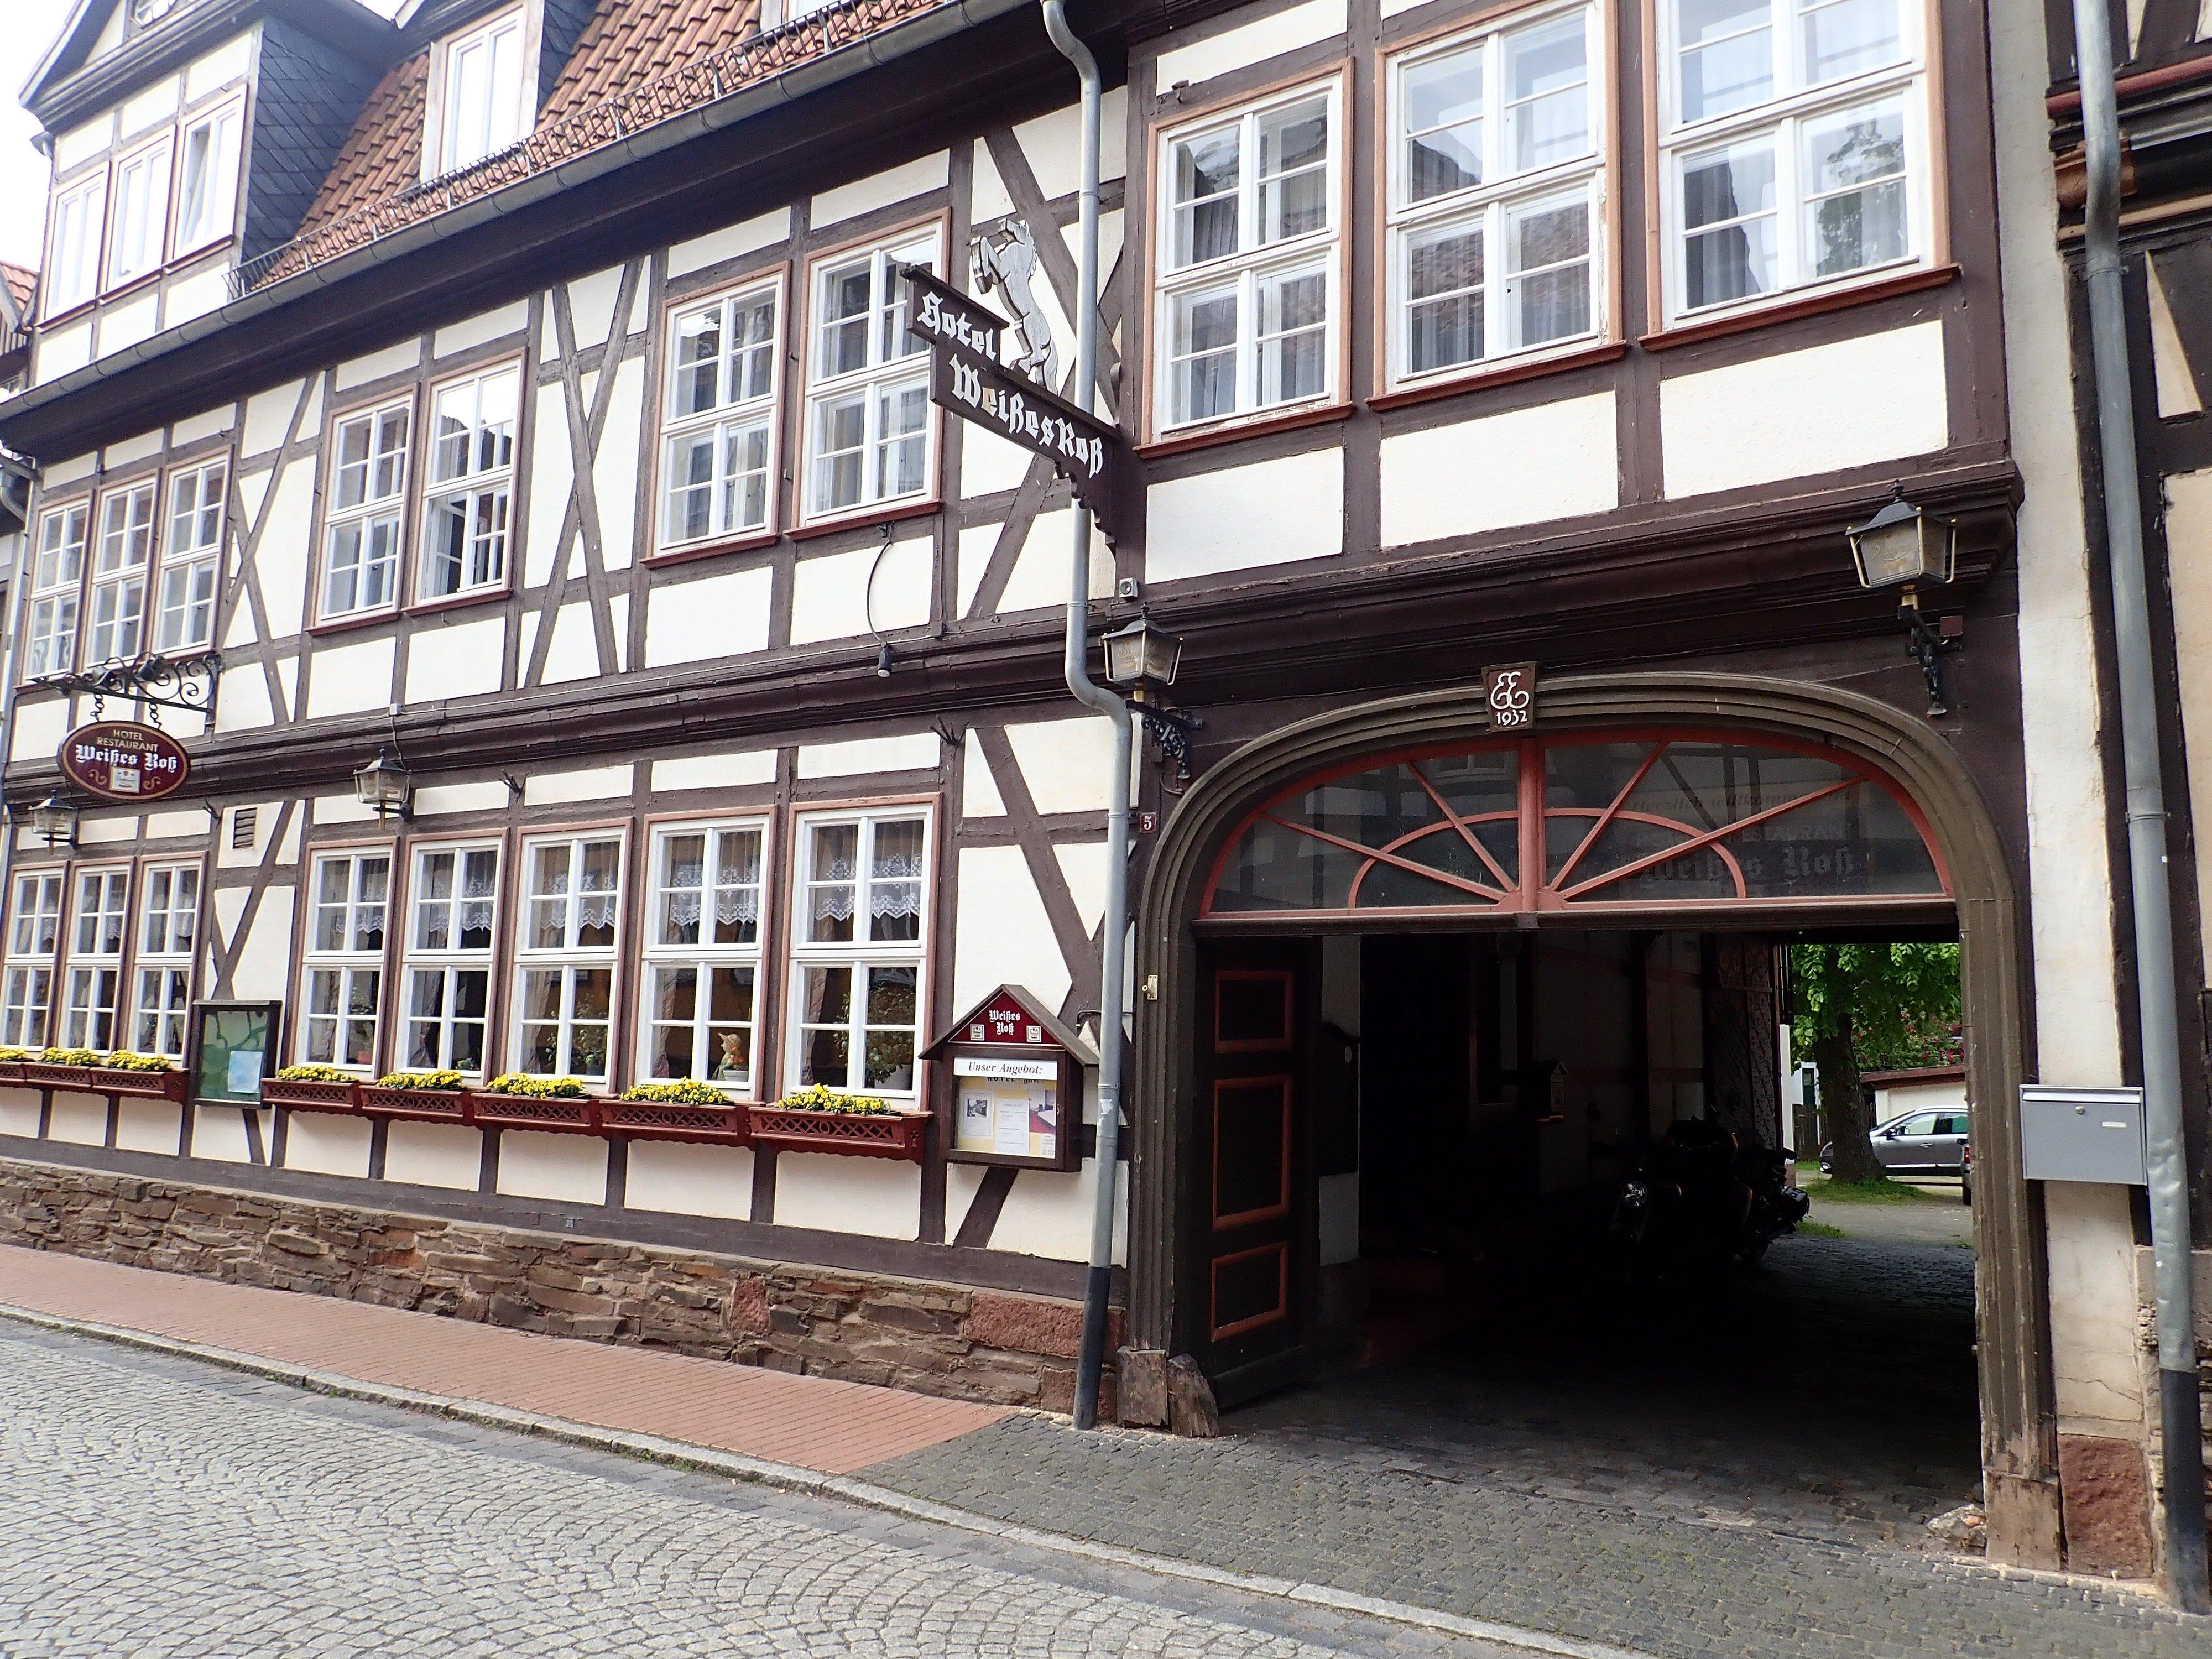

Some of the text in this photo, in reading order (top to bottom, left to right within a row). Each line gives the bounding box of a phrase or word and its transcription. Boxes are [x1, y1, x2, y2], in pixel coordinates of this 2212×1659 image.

[917, 291, 997, 361] Hotel
[1496, 709, 1527, 726] 1932
[113, 729, 143, 741] HOTEL
[97, 737, 159, 752] RESTAURANT
[1144, 816, 1152, 830] 5
[968, 1062, 1042, 1076] Unser Angebot:
